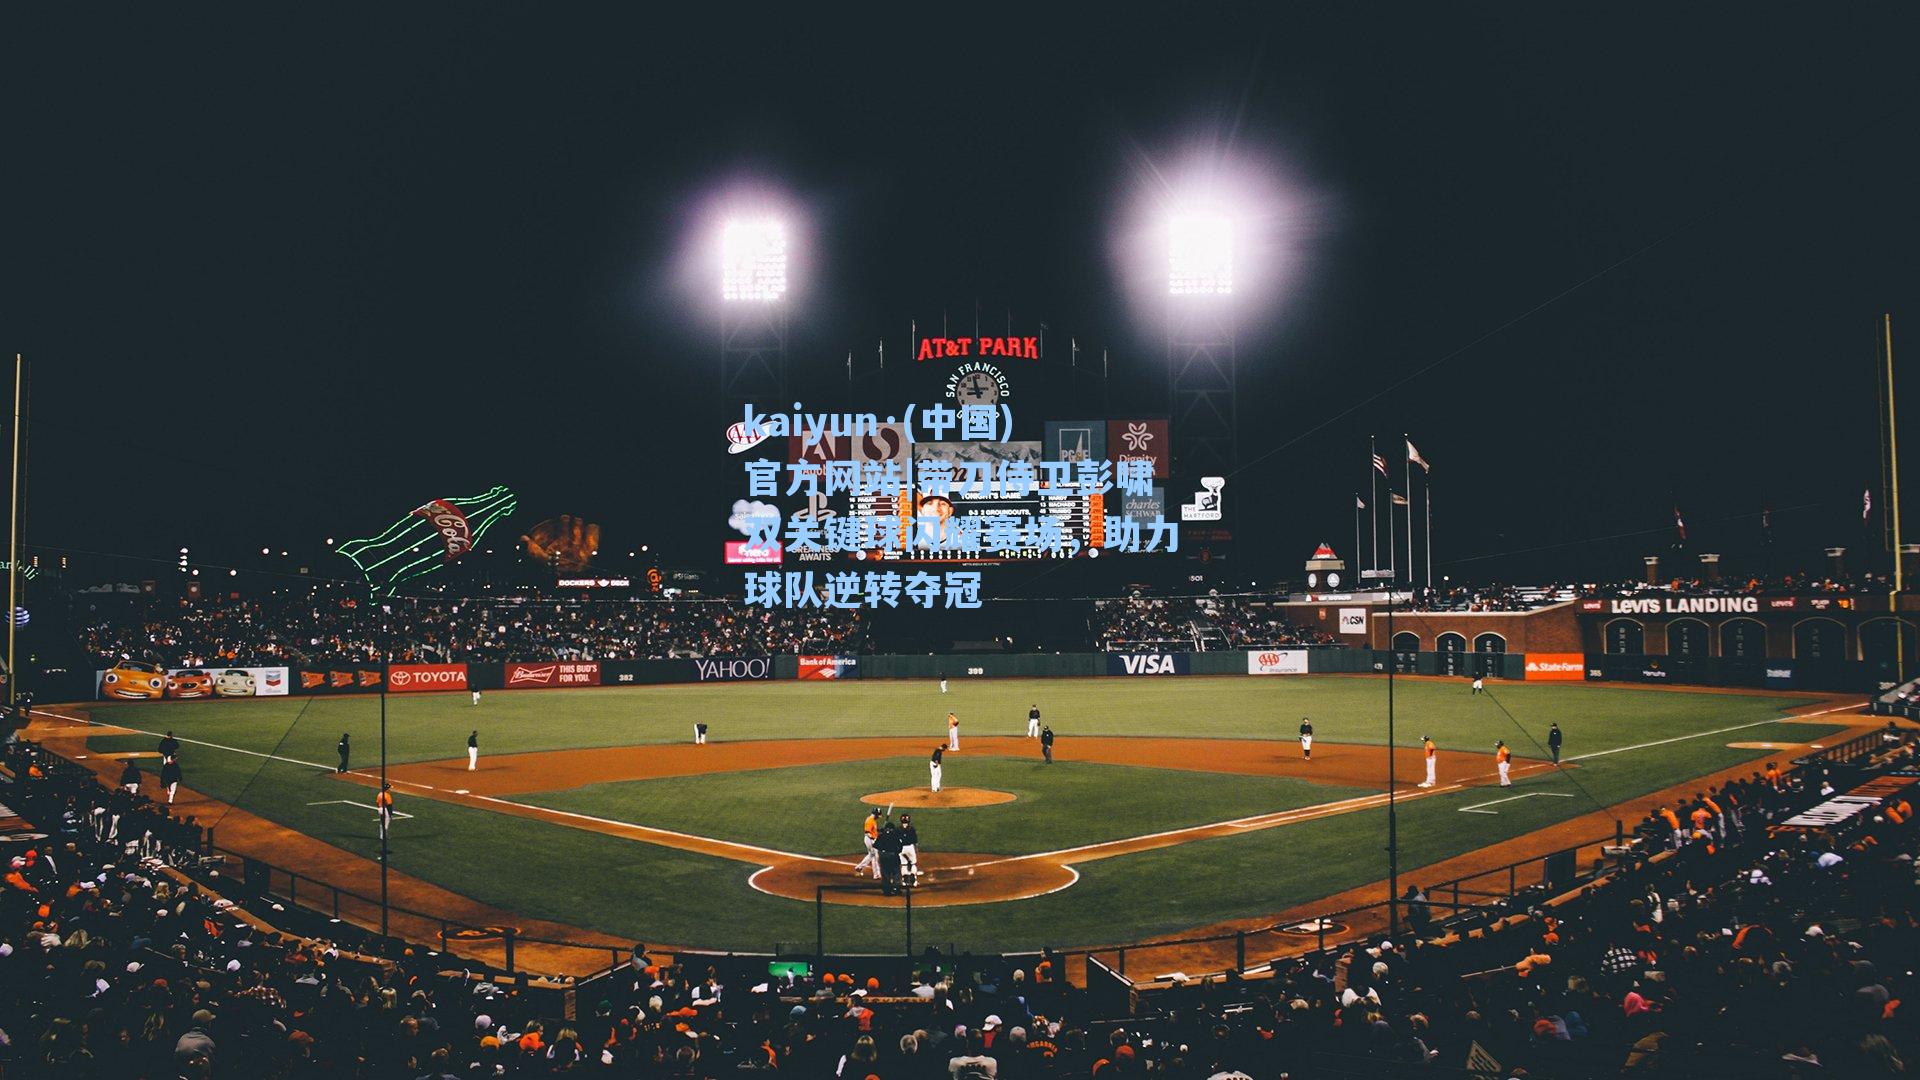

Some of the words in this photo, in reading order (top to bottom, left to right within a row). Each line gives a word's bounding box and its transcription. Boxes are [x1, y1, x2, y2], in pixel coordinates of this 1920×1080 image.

[917, 338, 972, 360] AT&T
[979, 336, 1038, 359] PARK
[946, 374, 960, 397] SAN
[958, 361, 1010, 397] FRANCISCO
[1119, 454, 1157, 466] Dignity
[1125, 499, 1161, 510] charles
[799, 553, 832, 561] AWAITS
[558, 579, 596, 587] DOCKERS
[610, 579, 630, 587] DECK
[1666, 597, 1758, 613] LANDING
[1350, 616, 1365, 626] CSN
[800, 658, 818, 666] Bank
[826, 657, 856, 667] America
[1119, 655, 1175, 675] VISA
[559, 664, 575, 674] THIS
[576, 664, 598, 674] BUD'S
[695, 658, 770, 681] YAHOO!
[967, 667, 983, 675] 399
[413, 671, 467, 683] TOYOTA
[559, 674, 573, 683] FOR
[574, 673, 590, 683] YOU.
